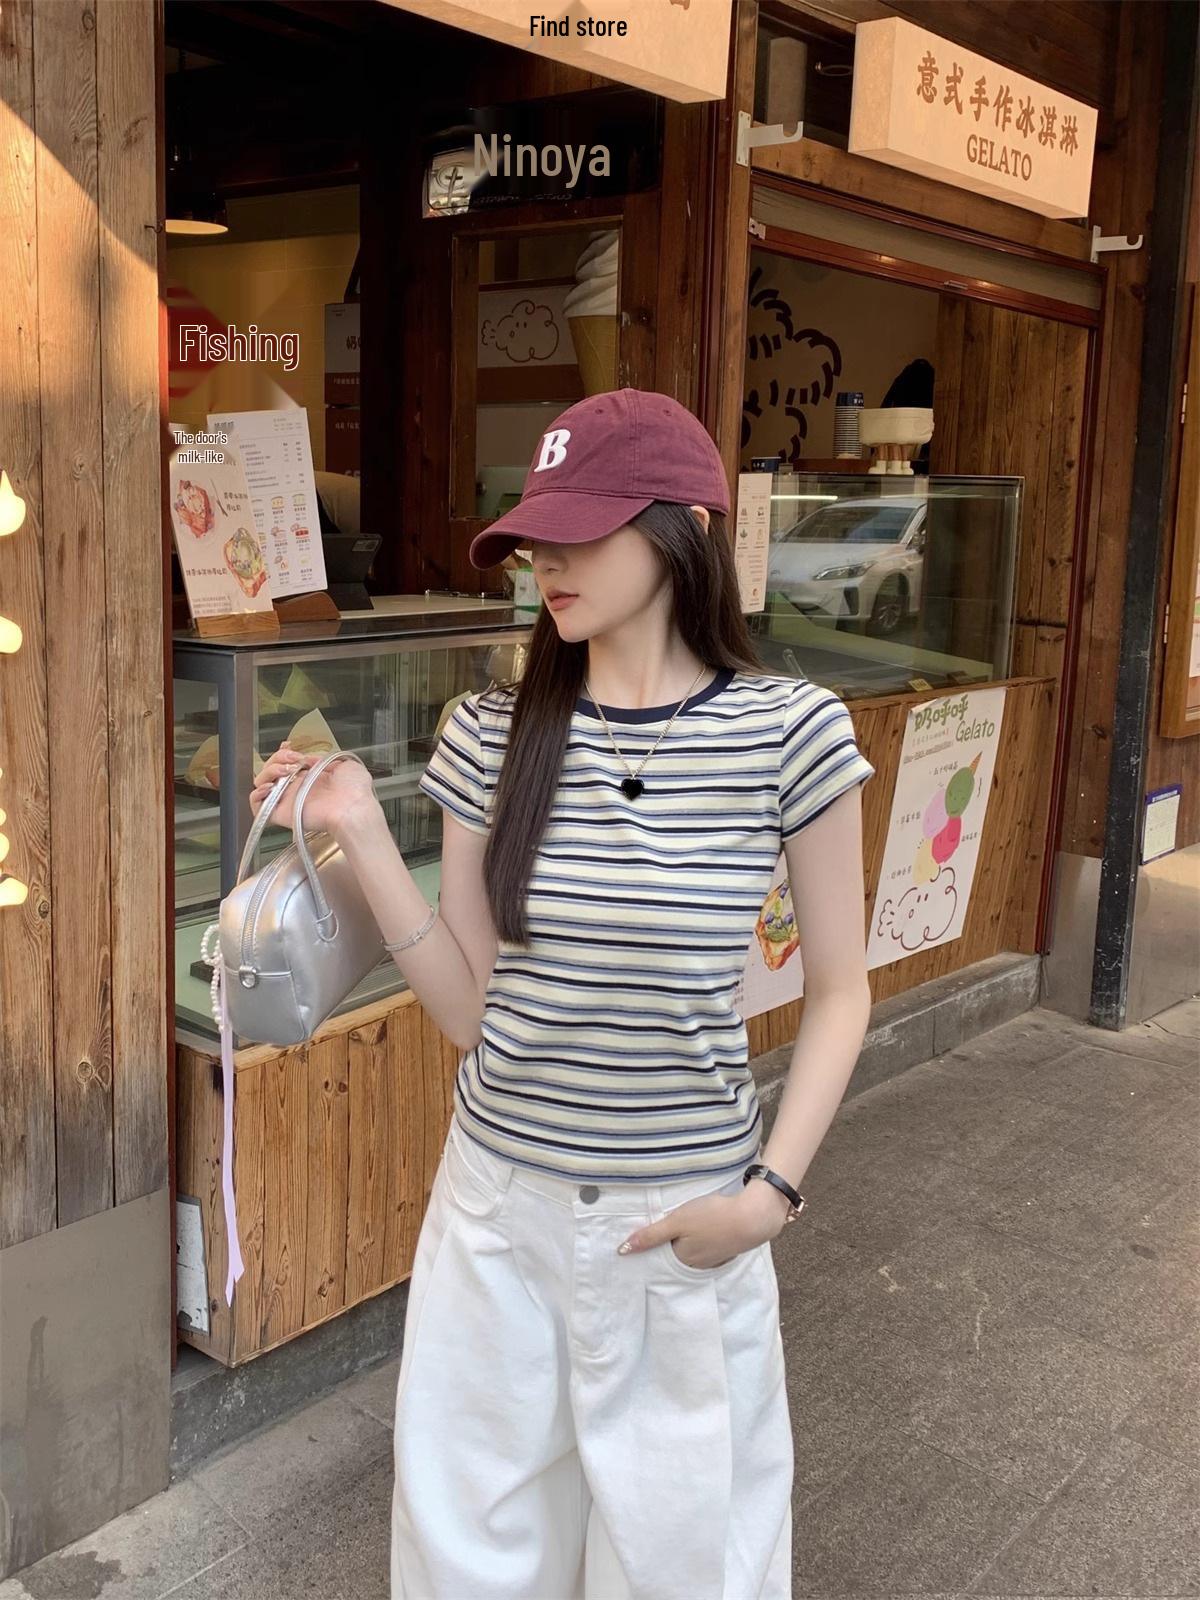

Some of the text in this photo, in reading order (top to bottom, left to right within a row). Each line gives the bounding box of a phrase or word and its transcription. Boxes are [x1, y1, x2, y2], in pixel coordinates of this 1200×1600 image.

[916, 50, 1079, 157] 意式手作冰淇淋
[966, 133, 1033, 181] GELATO
[533, 428, 571, 473] B
[955, 717, 995, 743] Gelato
